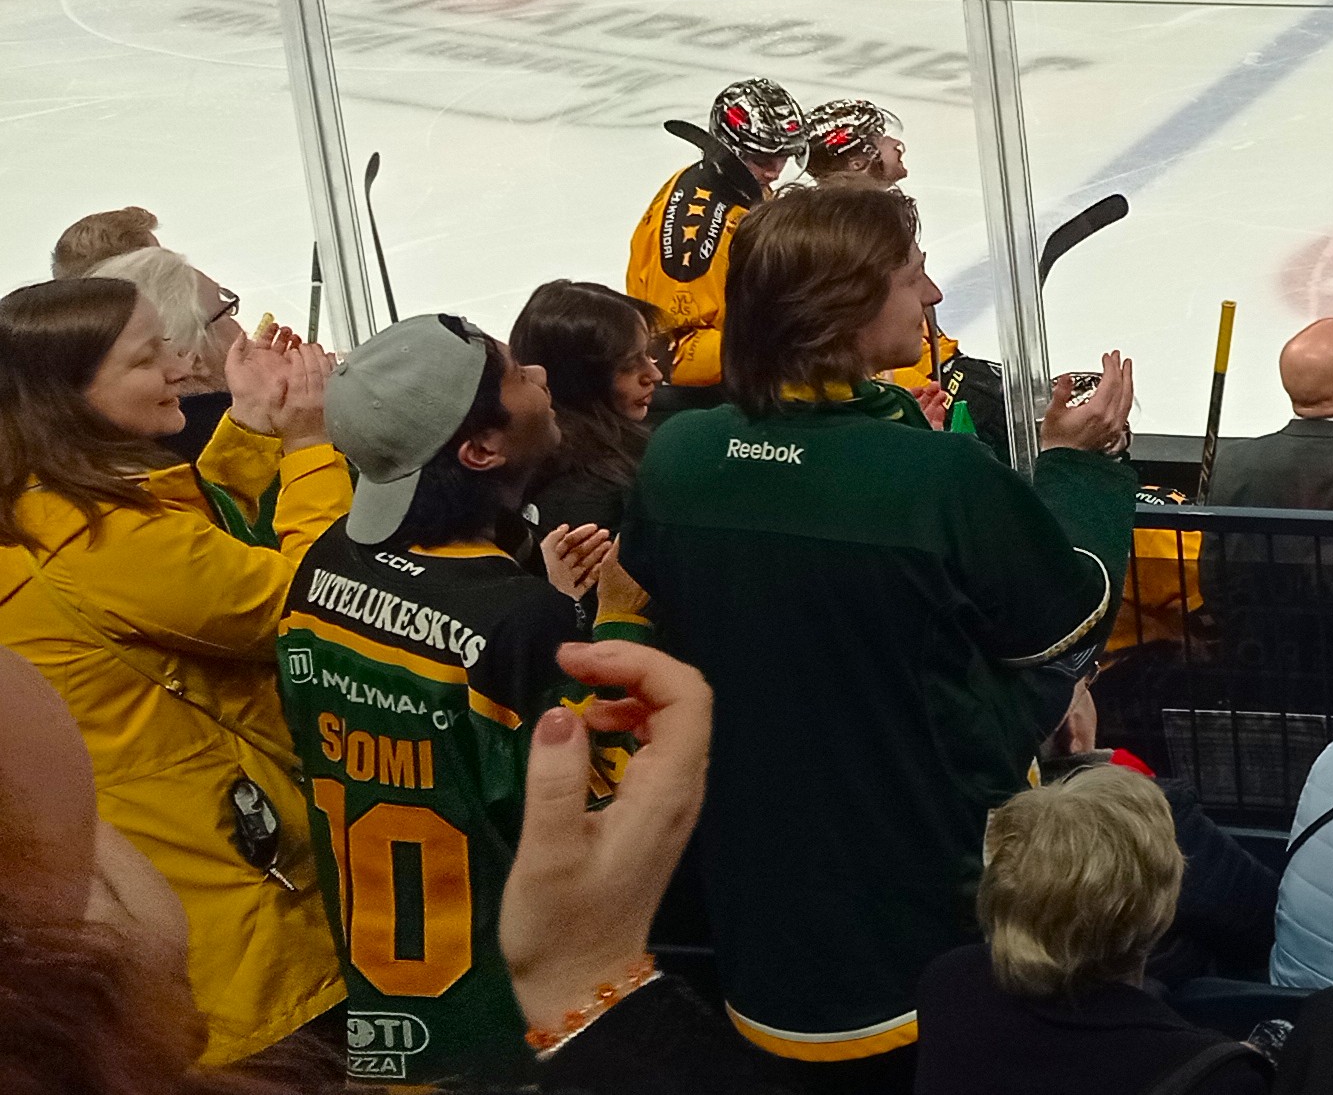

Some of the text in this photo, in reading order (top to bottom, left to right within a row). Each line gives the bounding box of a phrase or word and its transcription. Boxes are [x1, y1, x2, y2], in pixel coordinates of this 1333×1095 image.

[663, 205, 678, 259] HYUNDAI
[727, 438, 805, 465] Reebok
[375, 551, 426, 577] CCM
[318, 711, 435, 790] SOMI
